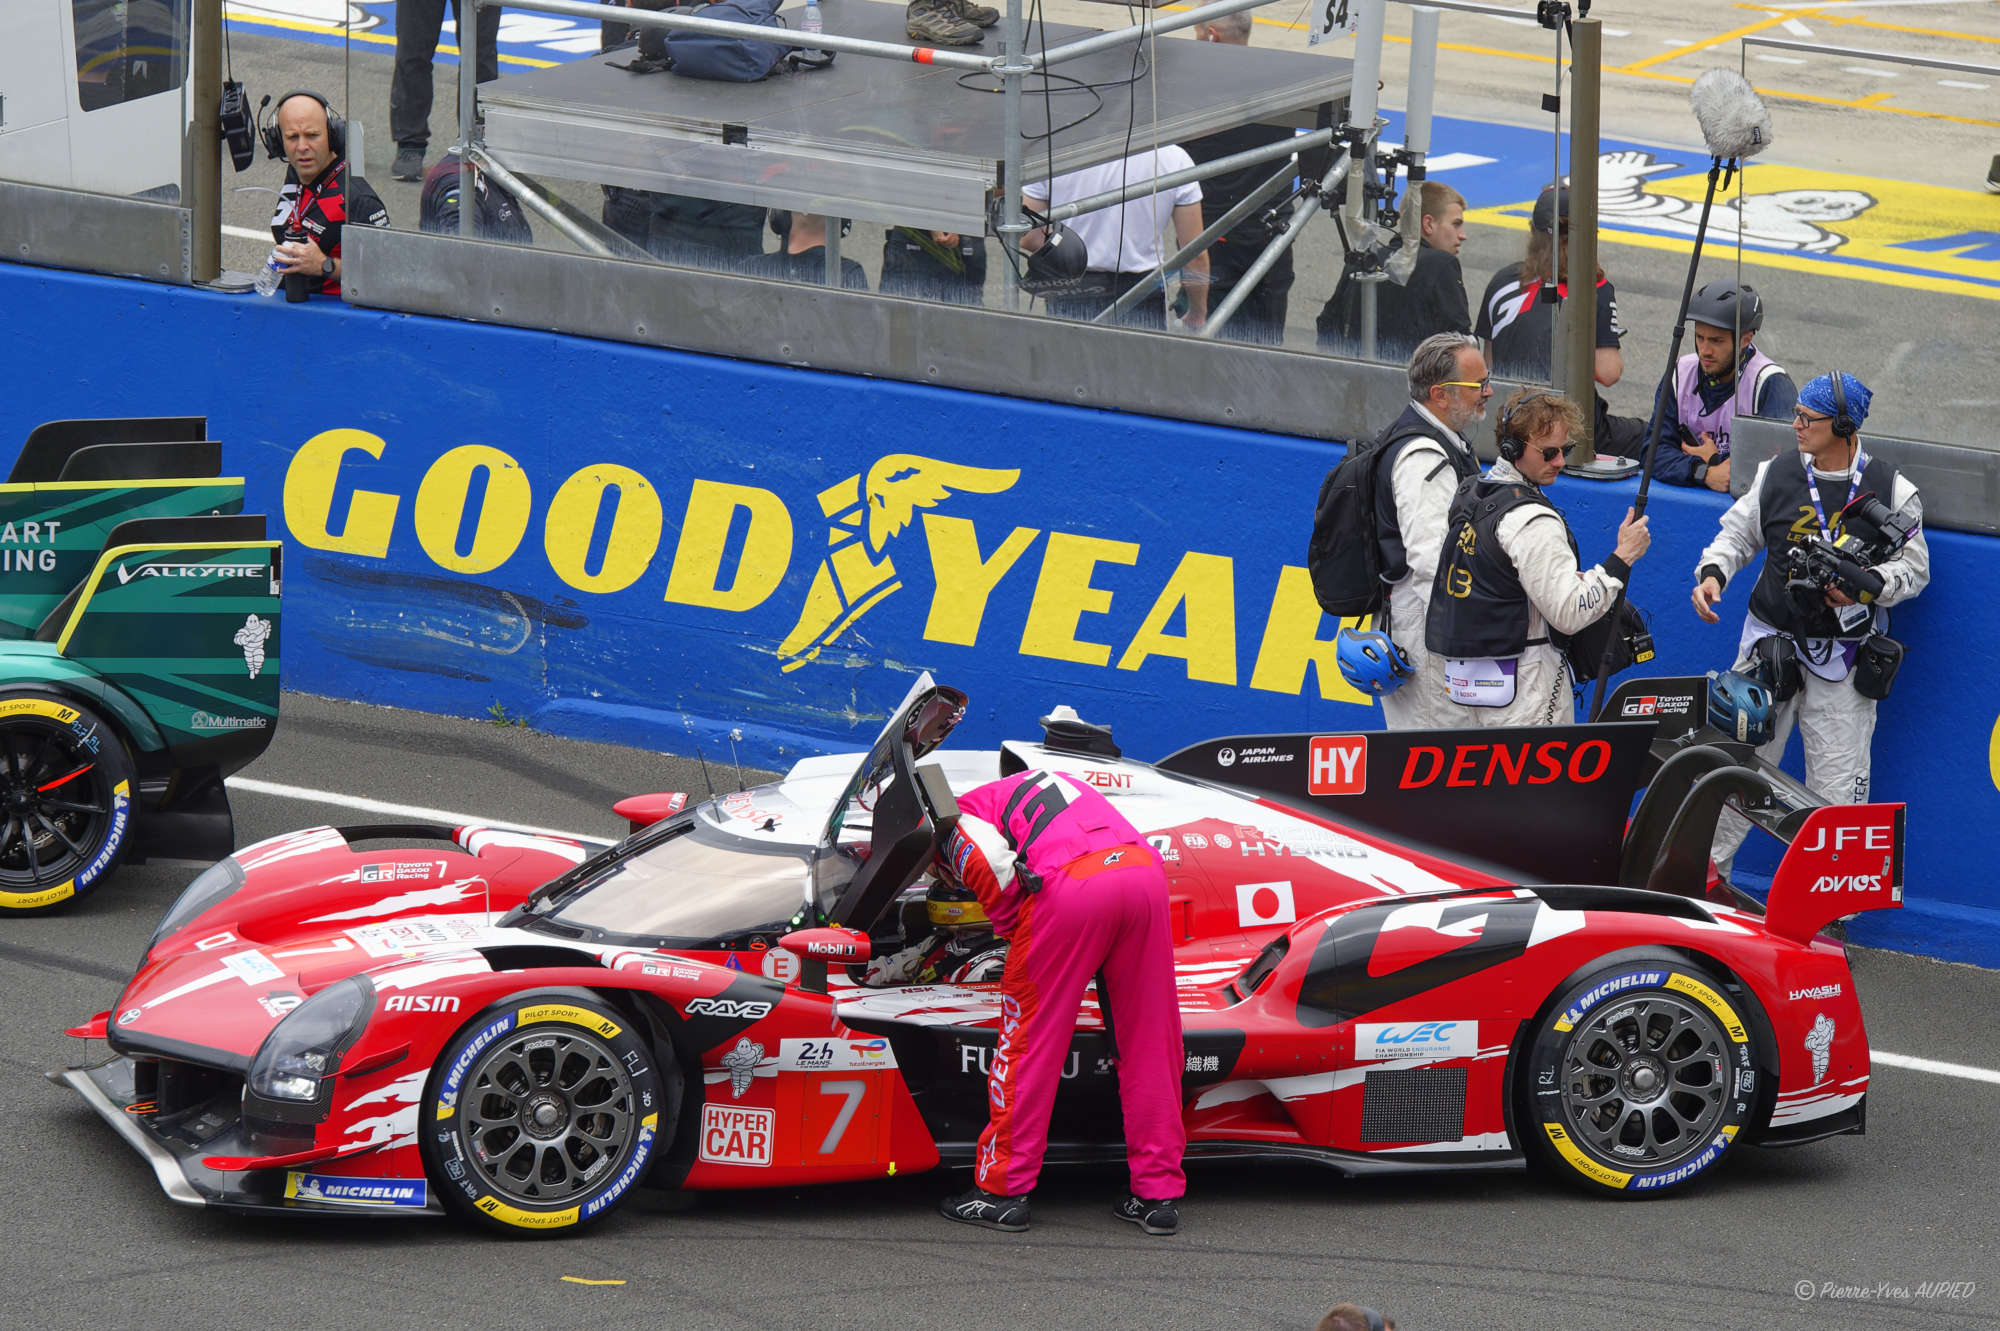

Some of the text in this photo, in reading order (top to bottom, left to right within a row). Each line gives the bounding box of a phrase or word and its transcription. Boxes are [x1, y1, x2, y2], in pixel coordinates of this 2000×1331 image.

[4, 549, 57, 571] ING
[117, 563, 265, 585] VALKYRIE
[57, 707, 73, 721] M
[1623, 703, 1654, 714] GR
[208, 716, 267, 728] Multimatic
[1239, 747, 1276, 757] JAPAN
[1241, 754, 1295, 764] AIRLINES
[1313, 747, 1362, 785] HY
[1398, 739, 1612, 790] DENSO
[1083, 770, 1134, 789] ZENT
[1803, 826, 1891, 851] JFE
[81, 811, 128, 886] MICHELIN
[363, 869, 394, 880] GR
[435, 860, 447, 878] 7
[16, 895, 46, 904] SPORT
[807, 941, 843, 955] Mobil
[773, 957, 789, 978] E
[900, 986, 937, 994] NSK
[1580, 973, 1660, 1010] MICHELIN
[1674, 978, 1722, 1008] PILOT SPORT
[1789, 983, 1842, 1000] HAYASHI
[384, 995, 460, 1013] AISIN
[685, 998, 771, 1018] RAYS
[524, 1009, 579, 1019] PILOT SPORT
[598, 1022, 616, 1034] M
[1376, 1022, 1457, 1044] WEC
[1730, 1025, 1744, 1038] M
[449, 1017, 510, 1088] MICHELIN
[991, 994, 1021, 1110] DENSO
[707, 1110, 768, 1131] HYPER
[817, 1080, 867, 1154] 7
[1549, 1127, 1564, 1140] M
[706, 1128, 767, 1159] CAR
[1574, 1157, 1622, 1184] PILOT SPORT
[1637, 1148, 1716, 1188] MICHELIN
[588, 1145, 648, 1215] MICHELIN
[325, 1184, 415, 1199] MICHELIN
[481, 1199, 499, 1213] M
[518, 1215, 573, 1225] PILOT SPORT
